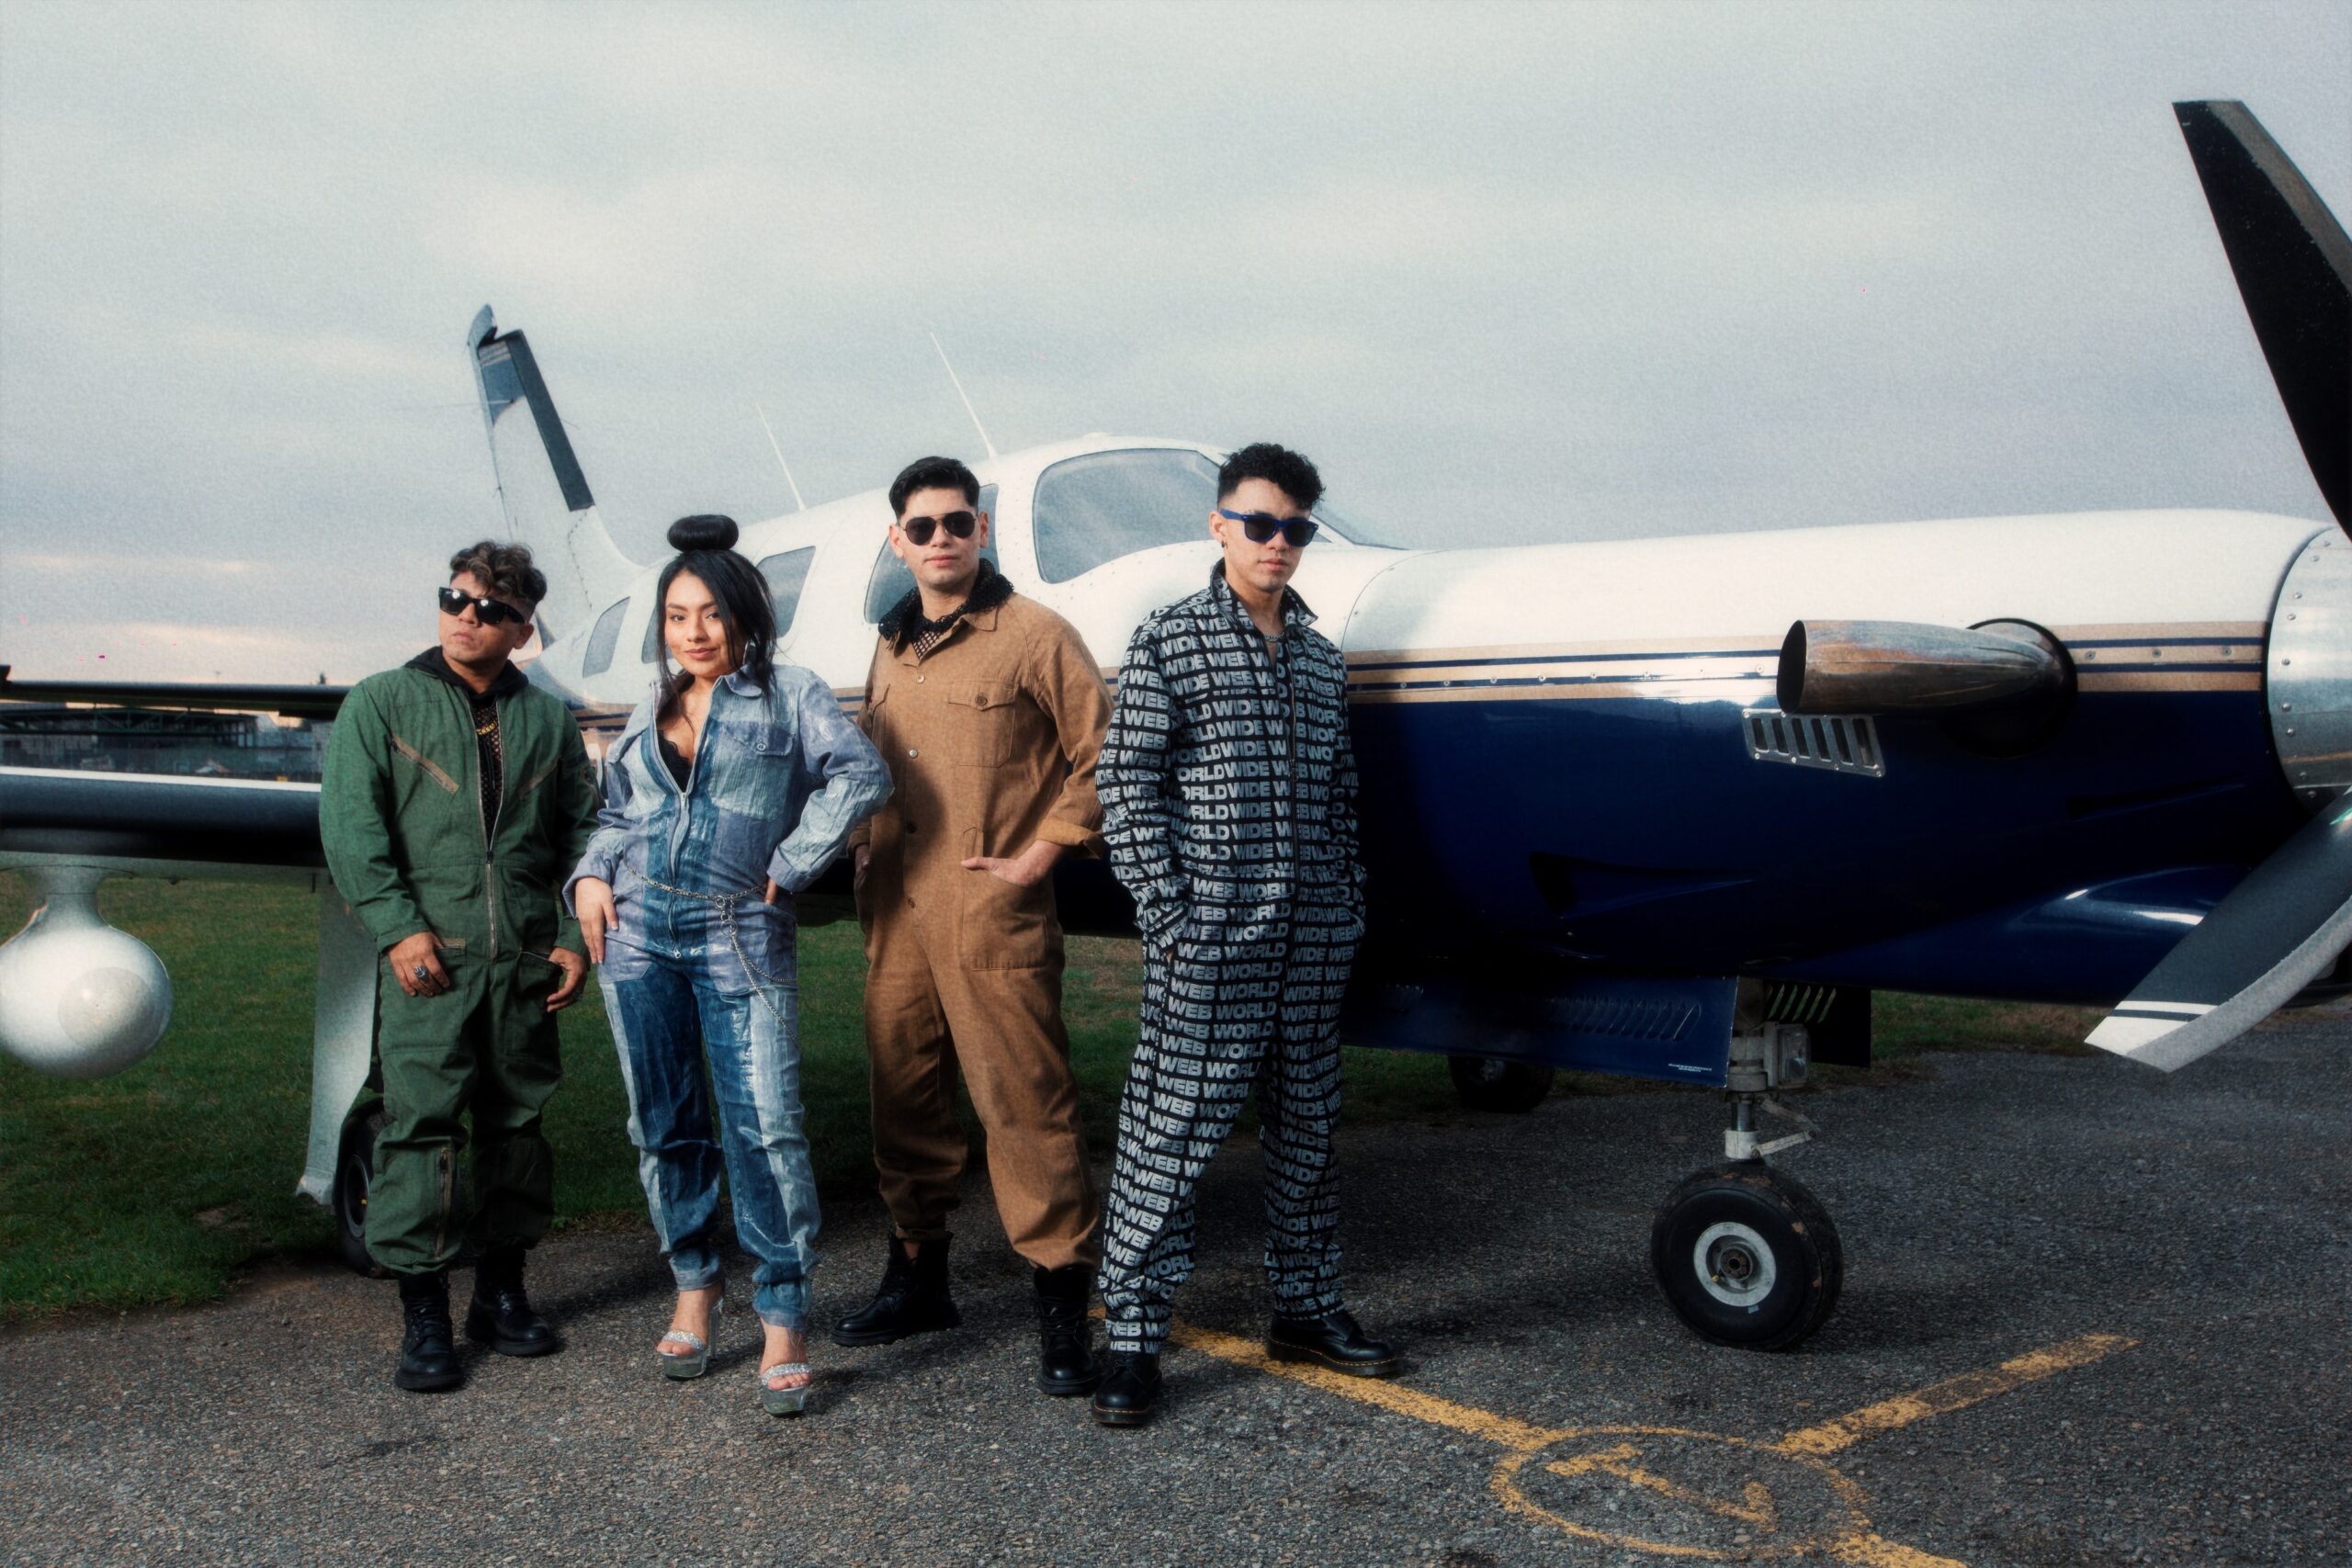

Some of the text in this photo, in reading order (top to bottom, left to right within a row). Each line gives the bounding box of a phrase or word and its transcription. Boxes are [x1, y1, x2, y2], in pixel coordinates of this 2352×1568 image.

[1151, 618, 1196, 638] WIDE
[1157, 635, 1201, 659] WIDE
[1159, 654, 1206, 678] WIDE
[1206, 651, 1250, 667] WEB
[1167, 673, 1210, 696] WIDE
[1211, 671, 1255, 687] WEB
[1125, 688, 1170, 710] WEB
[1212, 699, 1261, 717] WIDE
[1123, 708, 1170, 730] WEB
[1216, 720, 1264, 737] WIDE
[1123, 729, 1168, 750] WEB
[1220, 740, 1268, 758] WIDE
[1119, 750, 1161, 767] WEB
[1177, 764, 1225, 783] ORLD
[1224, 761, 1270, 778] WIDE
[1227, 781, 1272, 798] WIDE
[1229, 801, 1272, 819] WIDE
[1231, 822, 1273, 840] WIDE
[1232, 841, 1274, 860] WIDE
[1193, 876, 1237, 897] WEB
[1226, 922, 1289, 942] WORLD
[1295, 927, 1329, 943] WIDE
[1177, 942, 1222, 961] WEB
[1225, 942, 1288, 961] WORLD
[1291, 947, 1327, 963] WIDE
[1174, 959, 1219, 981] WEB
[1221, 962, 1283, 981] WORLD
[1286, 965, 1323, 982] WIDE
[1170, 976, 1216, 1001] WEB
[1219, 981, 1281, 1001] WORLD
[1283, 986, 1322, 1002] WIDE
[1168, 995, 1213, 1021] WEB
[1216, 1001, 1277, 1021] WORLD
[1164, 1014, 1210, 1040] WEB
[1213, 1021, 1275, 1040] WORLD
[1161, 1032, 1207, 1056] WEB
[1159, 1053, 1204, 1077] WEB
[1156, 1072, 1200, 1098] WEB
[1153, 1091, 1197, 1119] WEB
[1149, 1110, 1192, 1136] WEB
[1145, 1131, 1185, 1155] WEB
[1136, 1148, 1182, 1175] WEB
[1134, 1168, 1177, 1194] WEB
[1127, 1187, 1170, 1213] WEB
[1124, 1205, 1164, 1232] WEB
